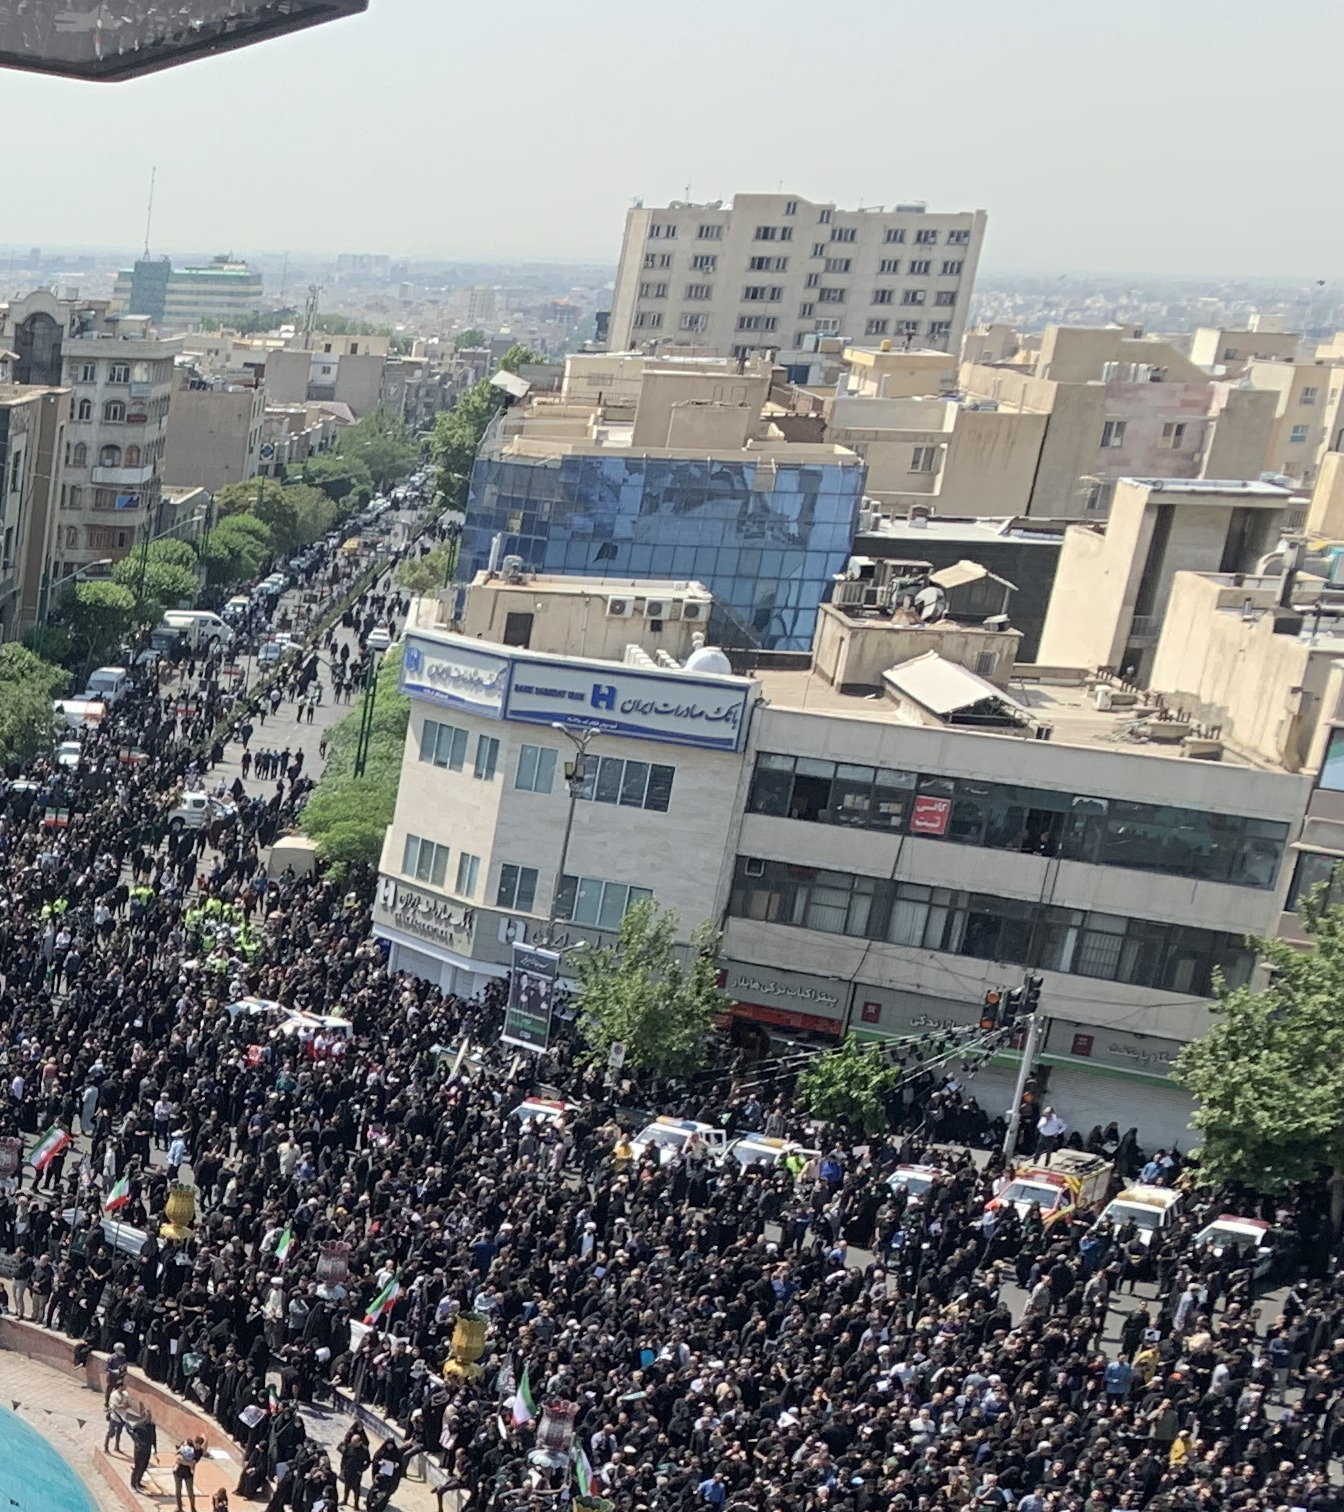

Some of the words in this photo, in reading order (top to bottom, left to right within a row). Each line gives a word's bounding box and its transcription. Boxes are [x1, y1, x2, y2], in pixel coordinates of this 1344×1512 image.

[620, 698, 655, 715] ایران
[654, 702, 704, 719] صادرات
[704, 701, 742, 730] بانک
[916, 802, 948, 812] کافی
[760, 981, 789, 996] ترکی
